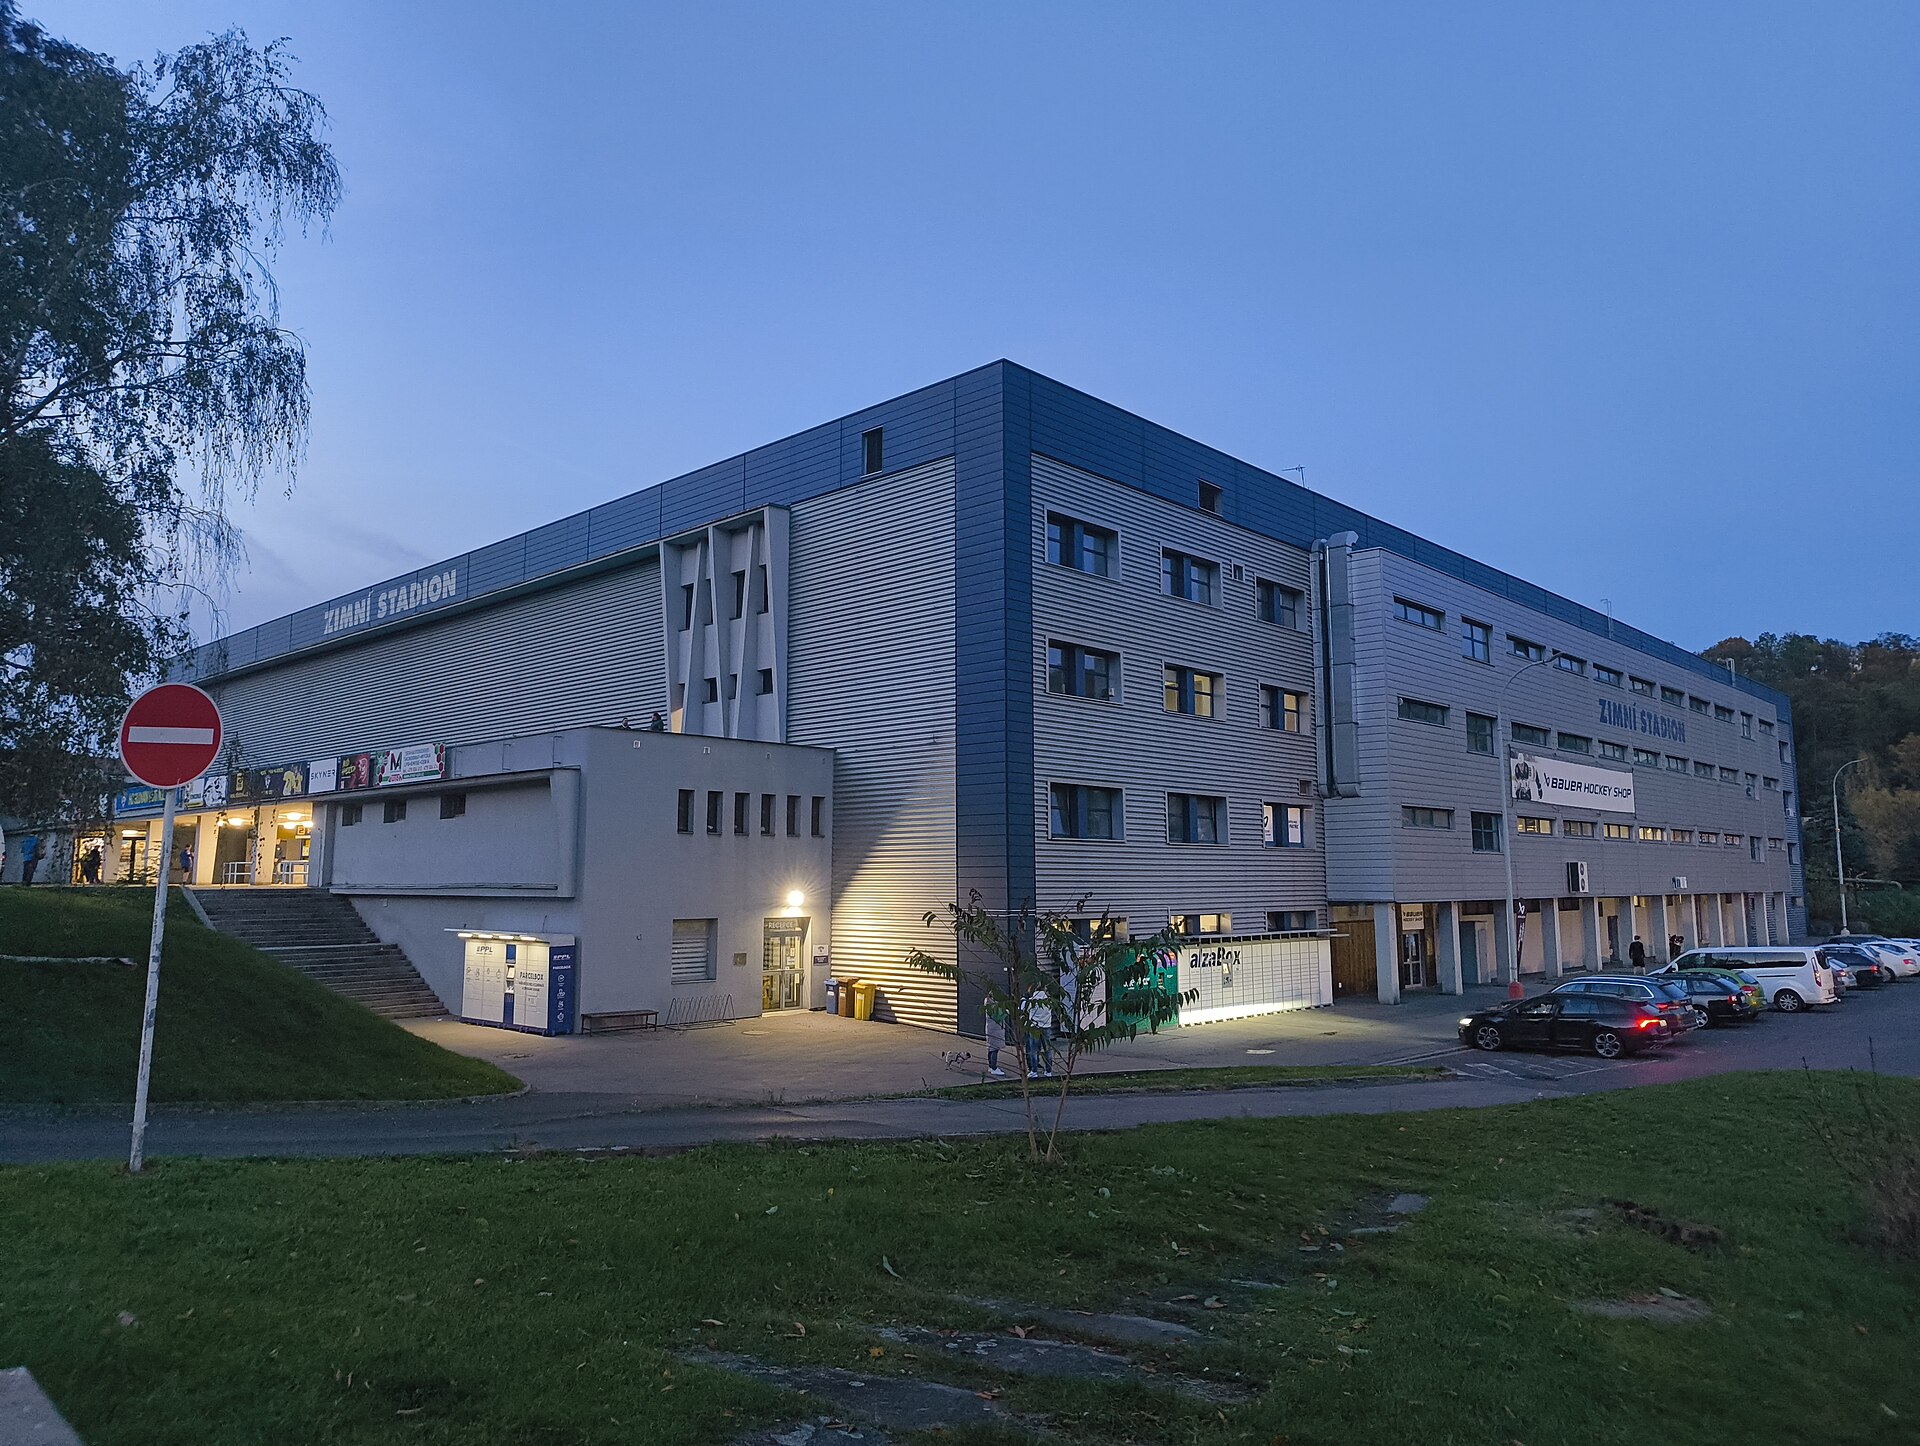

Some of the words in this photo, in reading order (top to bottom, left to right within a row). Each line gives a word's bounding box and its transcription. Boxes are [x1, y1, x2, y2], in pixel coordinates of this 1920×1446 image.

[324, 589, 373, 634] ZIMNÍ
[377, 569, 457, 619] STADION
[1600, 699, 1637, 731] ZIMNÍ
[1641, 709, 1686, 743] STADION
[311, 769, 335, 780] SKYNER
[1584, 782, 1612, 797] HOCKEY
[1613, 787, 1631, 798] SHOP
[768, 921, 794, 929] RECEPCE
[1190, 947, 1241, 968] alzaBox
[519, 971, 544, 980] PARCELBOX
